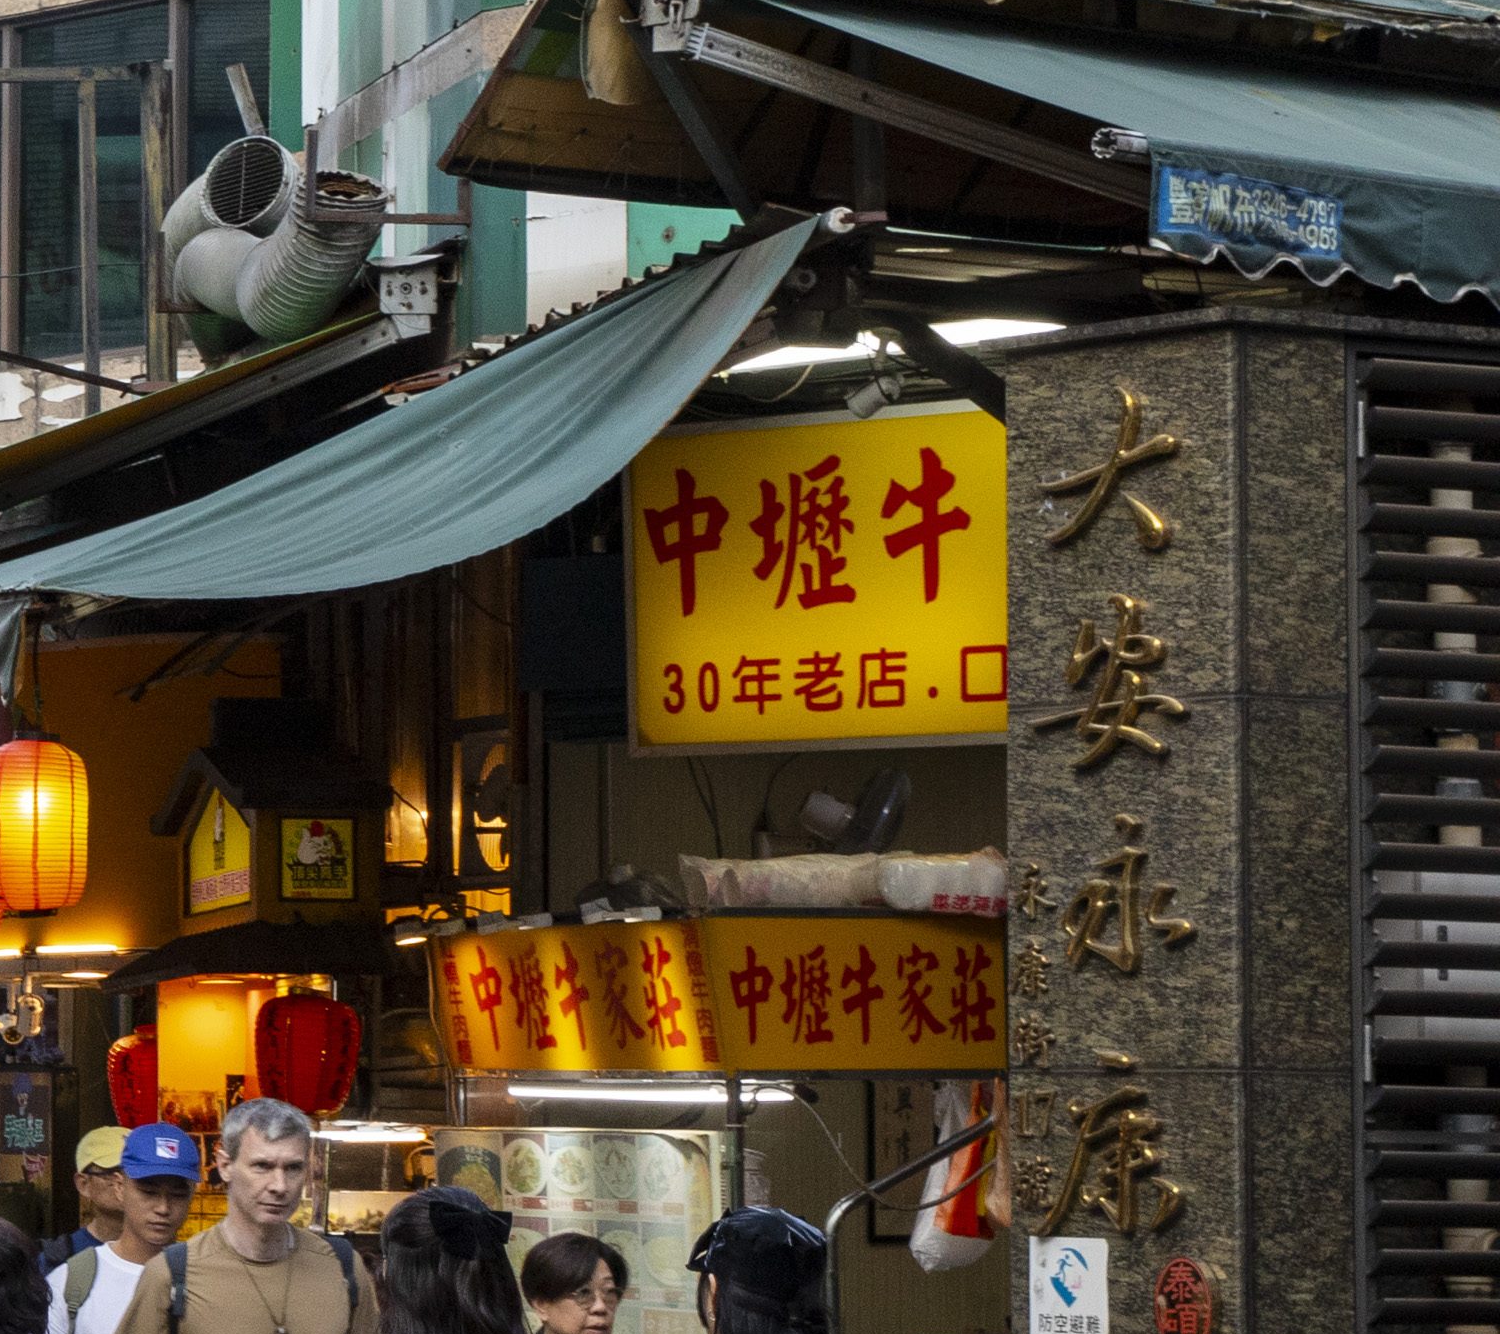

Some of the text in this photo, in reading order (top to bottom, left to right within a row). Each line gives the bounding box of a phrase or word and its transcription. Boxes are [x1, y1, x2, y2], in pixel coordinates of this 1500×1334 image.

[729, 942, 997, 1047] 中壢牛家莊
[1038, 1312, 1101, 1334] 防空避難
